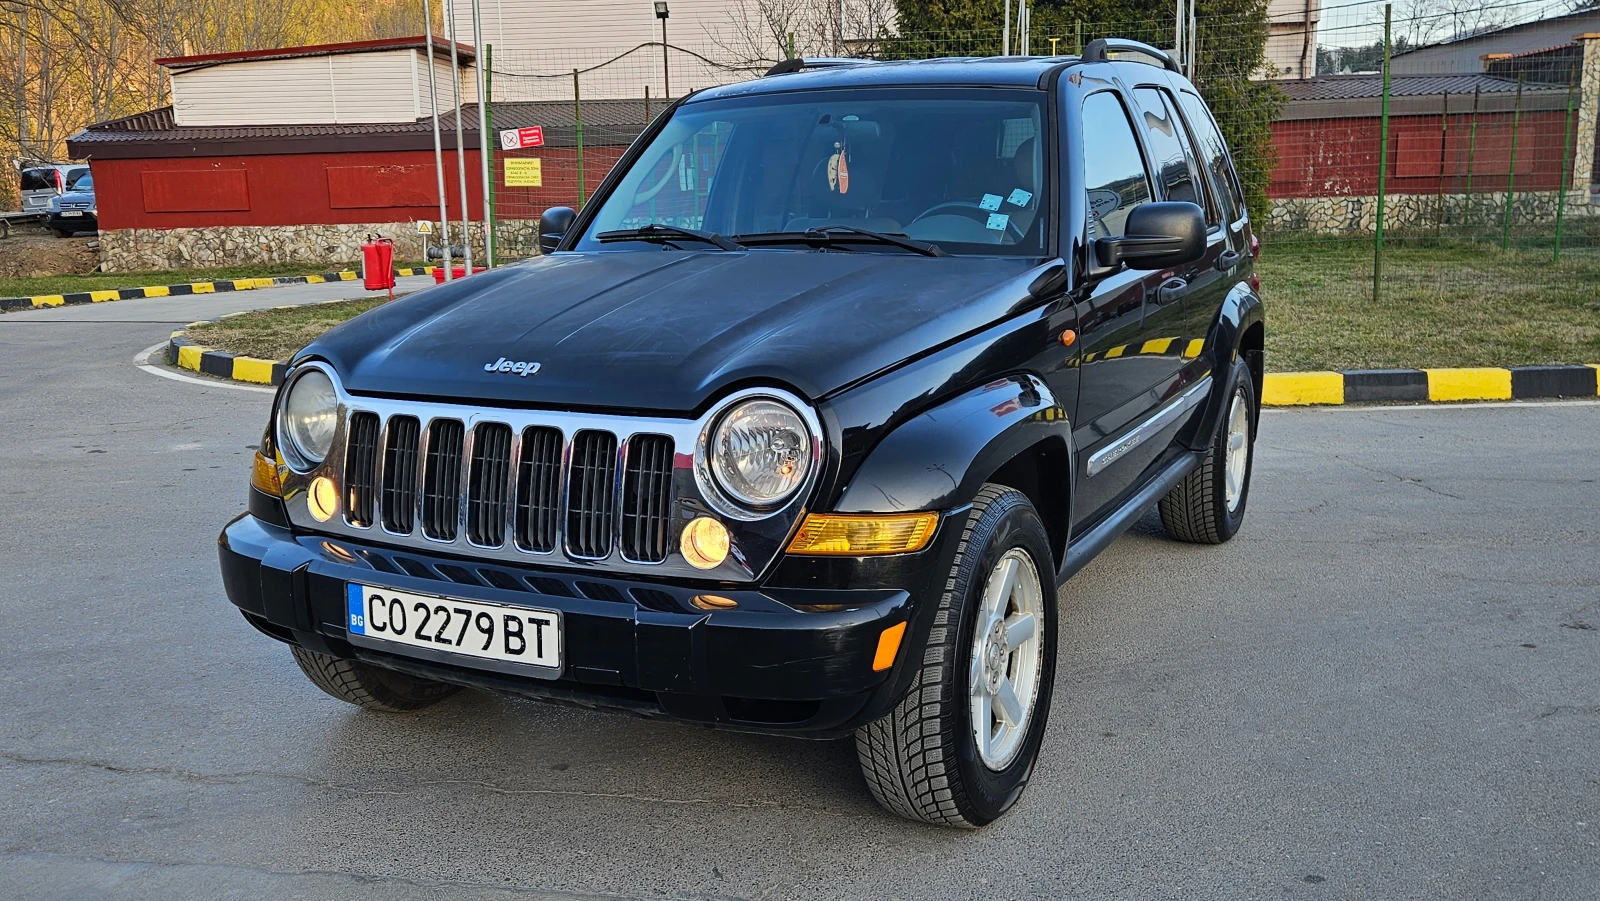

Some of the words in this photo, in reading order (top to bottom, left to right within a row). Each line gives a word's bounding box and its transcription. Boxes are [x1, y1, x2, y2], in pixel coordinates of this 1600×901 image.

[484, 357, 541, 377] Jeep
[351, 614, 363, 626] BG
[413, 602, 495, 651] 2279
[503, 614, 551, 659] BT
